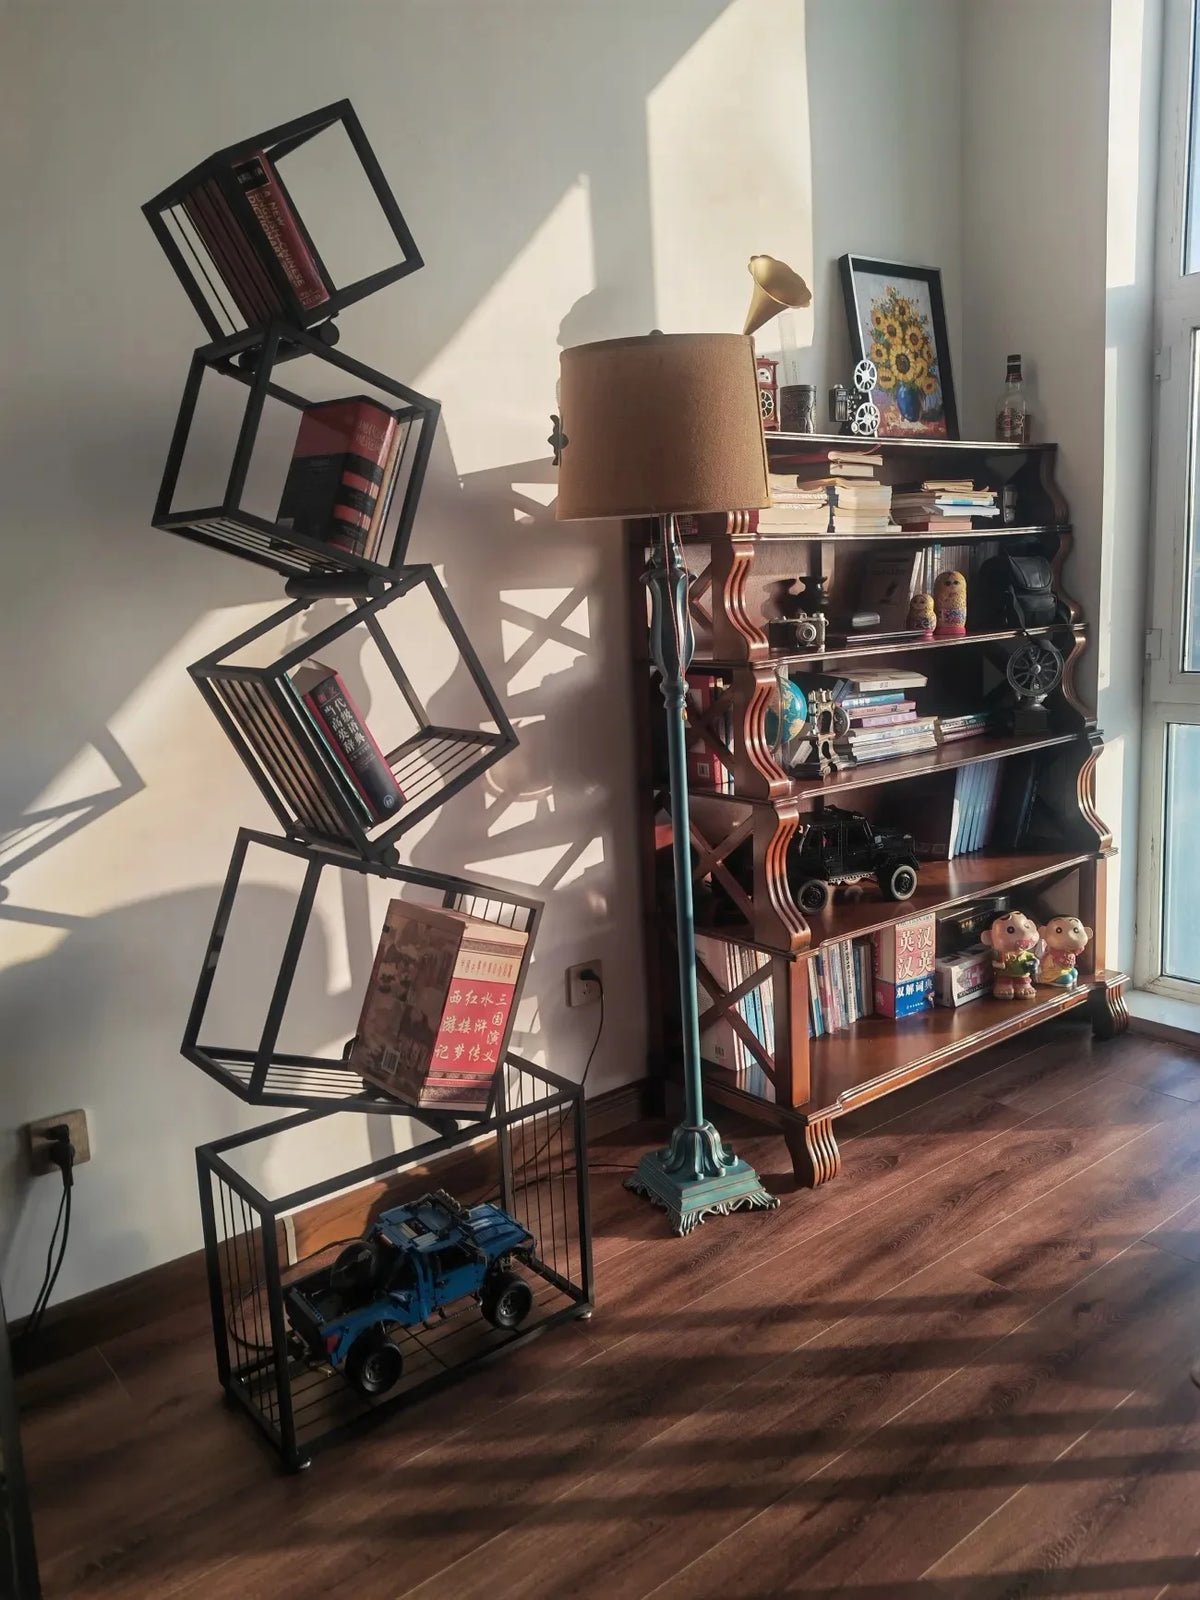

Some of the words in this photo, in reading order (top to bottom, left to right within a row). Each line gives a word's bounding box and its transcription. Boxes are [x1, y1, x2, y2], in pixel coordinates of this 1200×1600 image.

[248, 196, 283, 258] DICTIONARY
[270, 202, 285, 226] NEW
[898, 950, 933, 979] 汉英
[899, 926, 933, 955] 英汉
[454, 990, 478, 1063] 红楼梦
[468, 991, 494, 1062] 水浒传
[482, 993, 508, 1063] 三国演义
